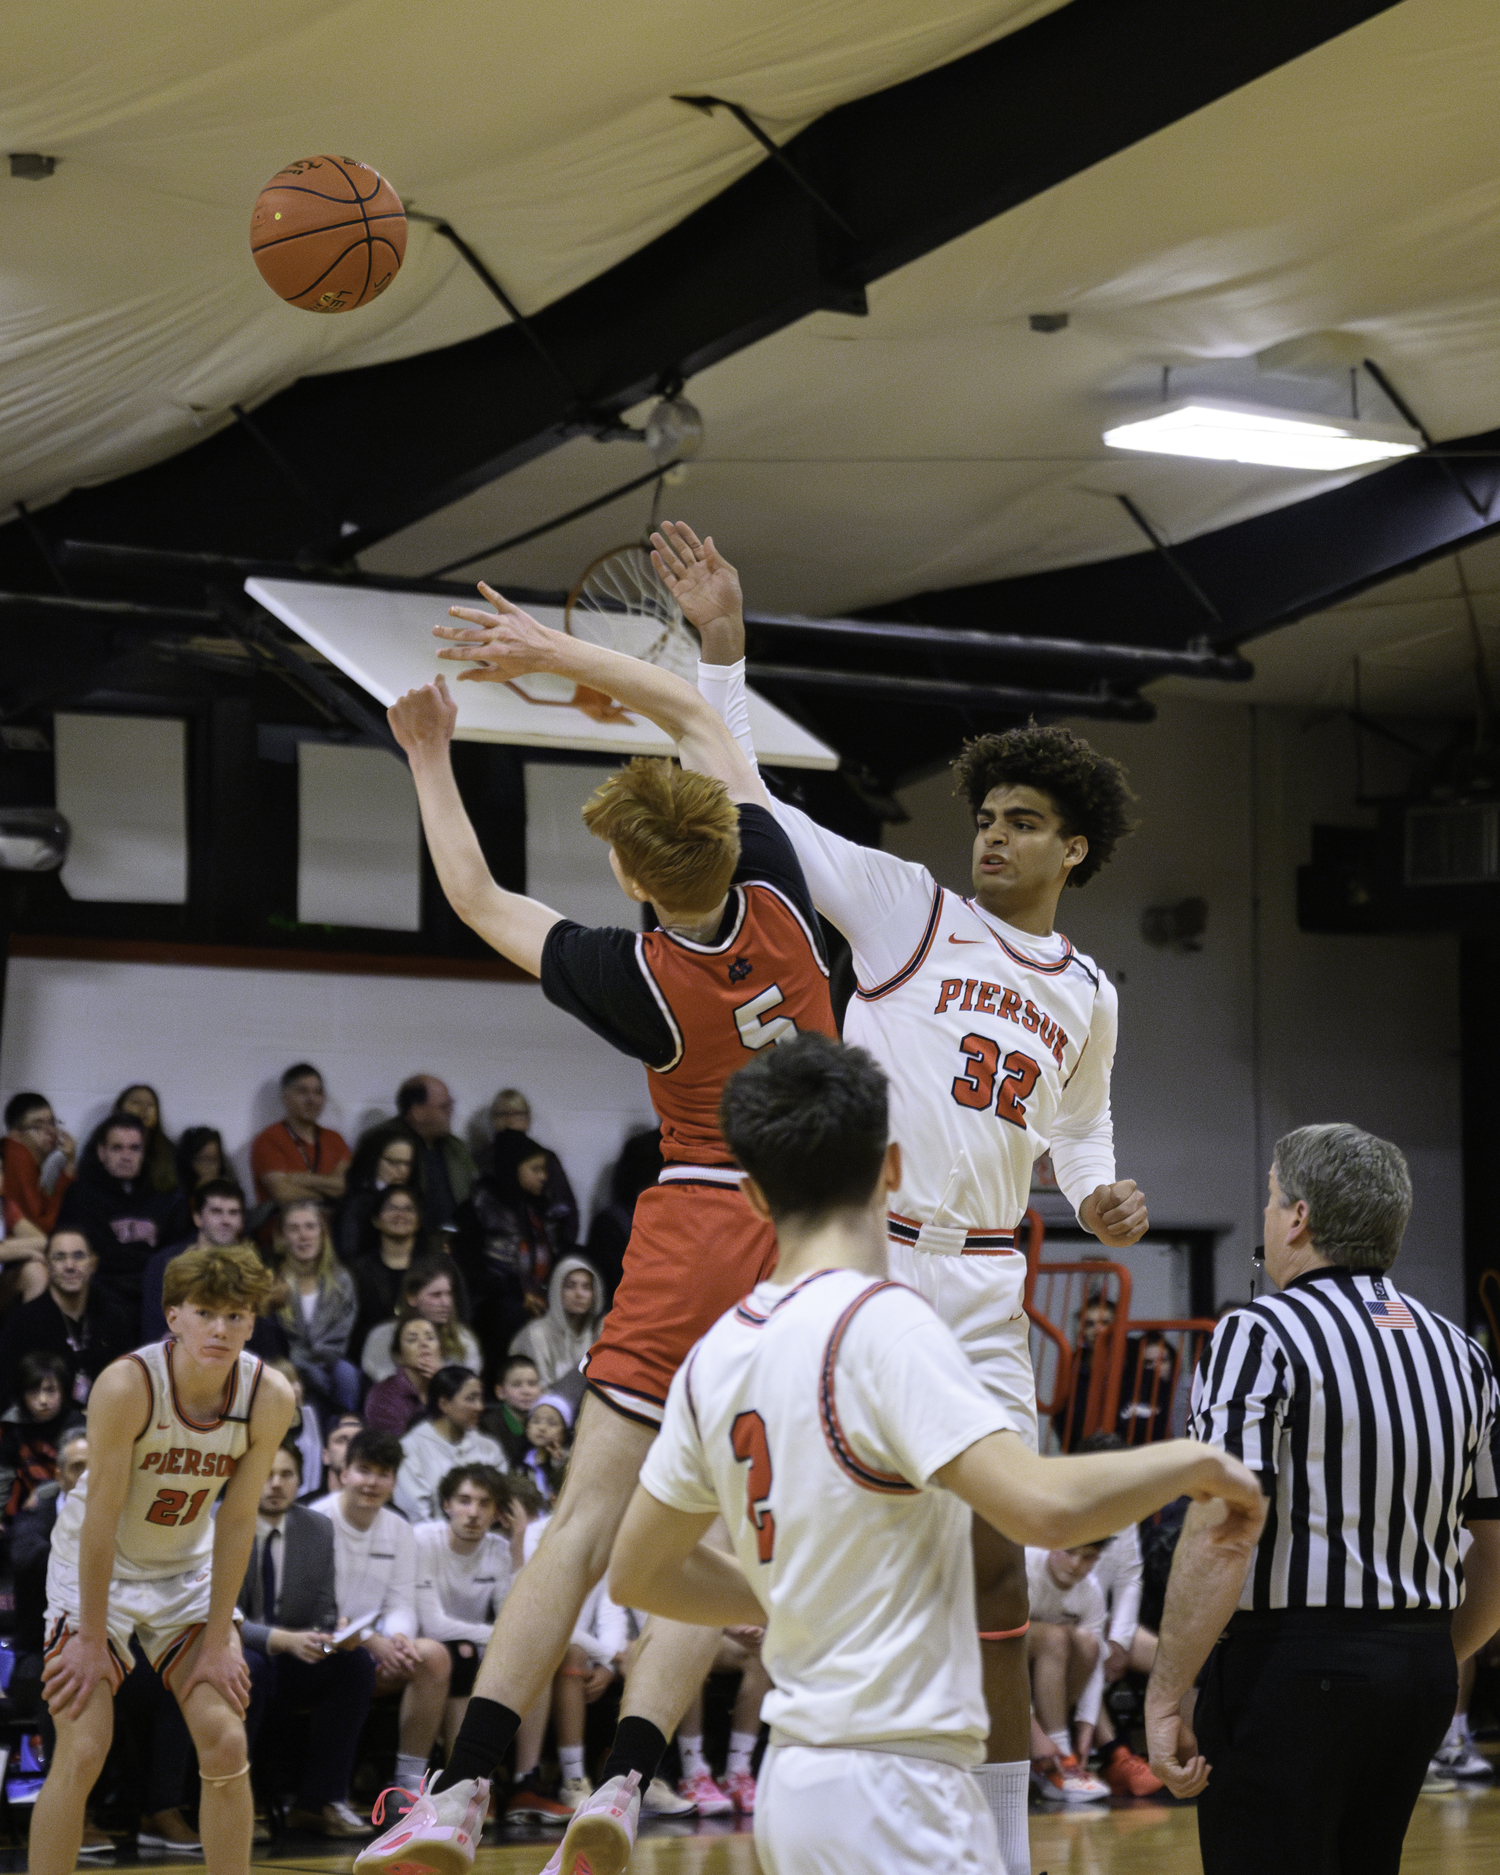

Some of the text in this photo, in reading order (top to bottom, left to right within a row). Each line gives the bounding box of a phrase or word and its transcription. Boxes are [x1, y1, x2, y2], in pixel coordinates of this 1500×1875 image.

[733, 982, 799, 1052] 5
[951, 1032, 1042, 1131] 32
[139, 1447, 236, 1478] PIERSO
[144, 1488, 211, 1527] 21
